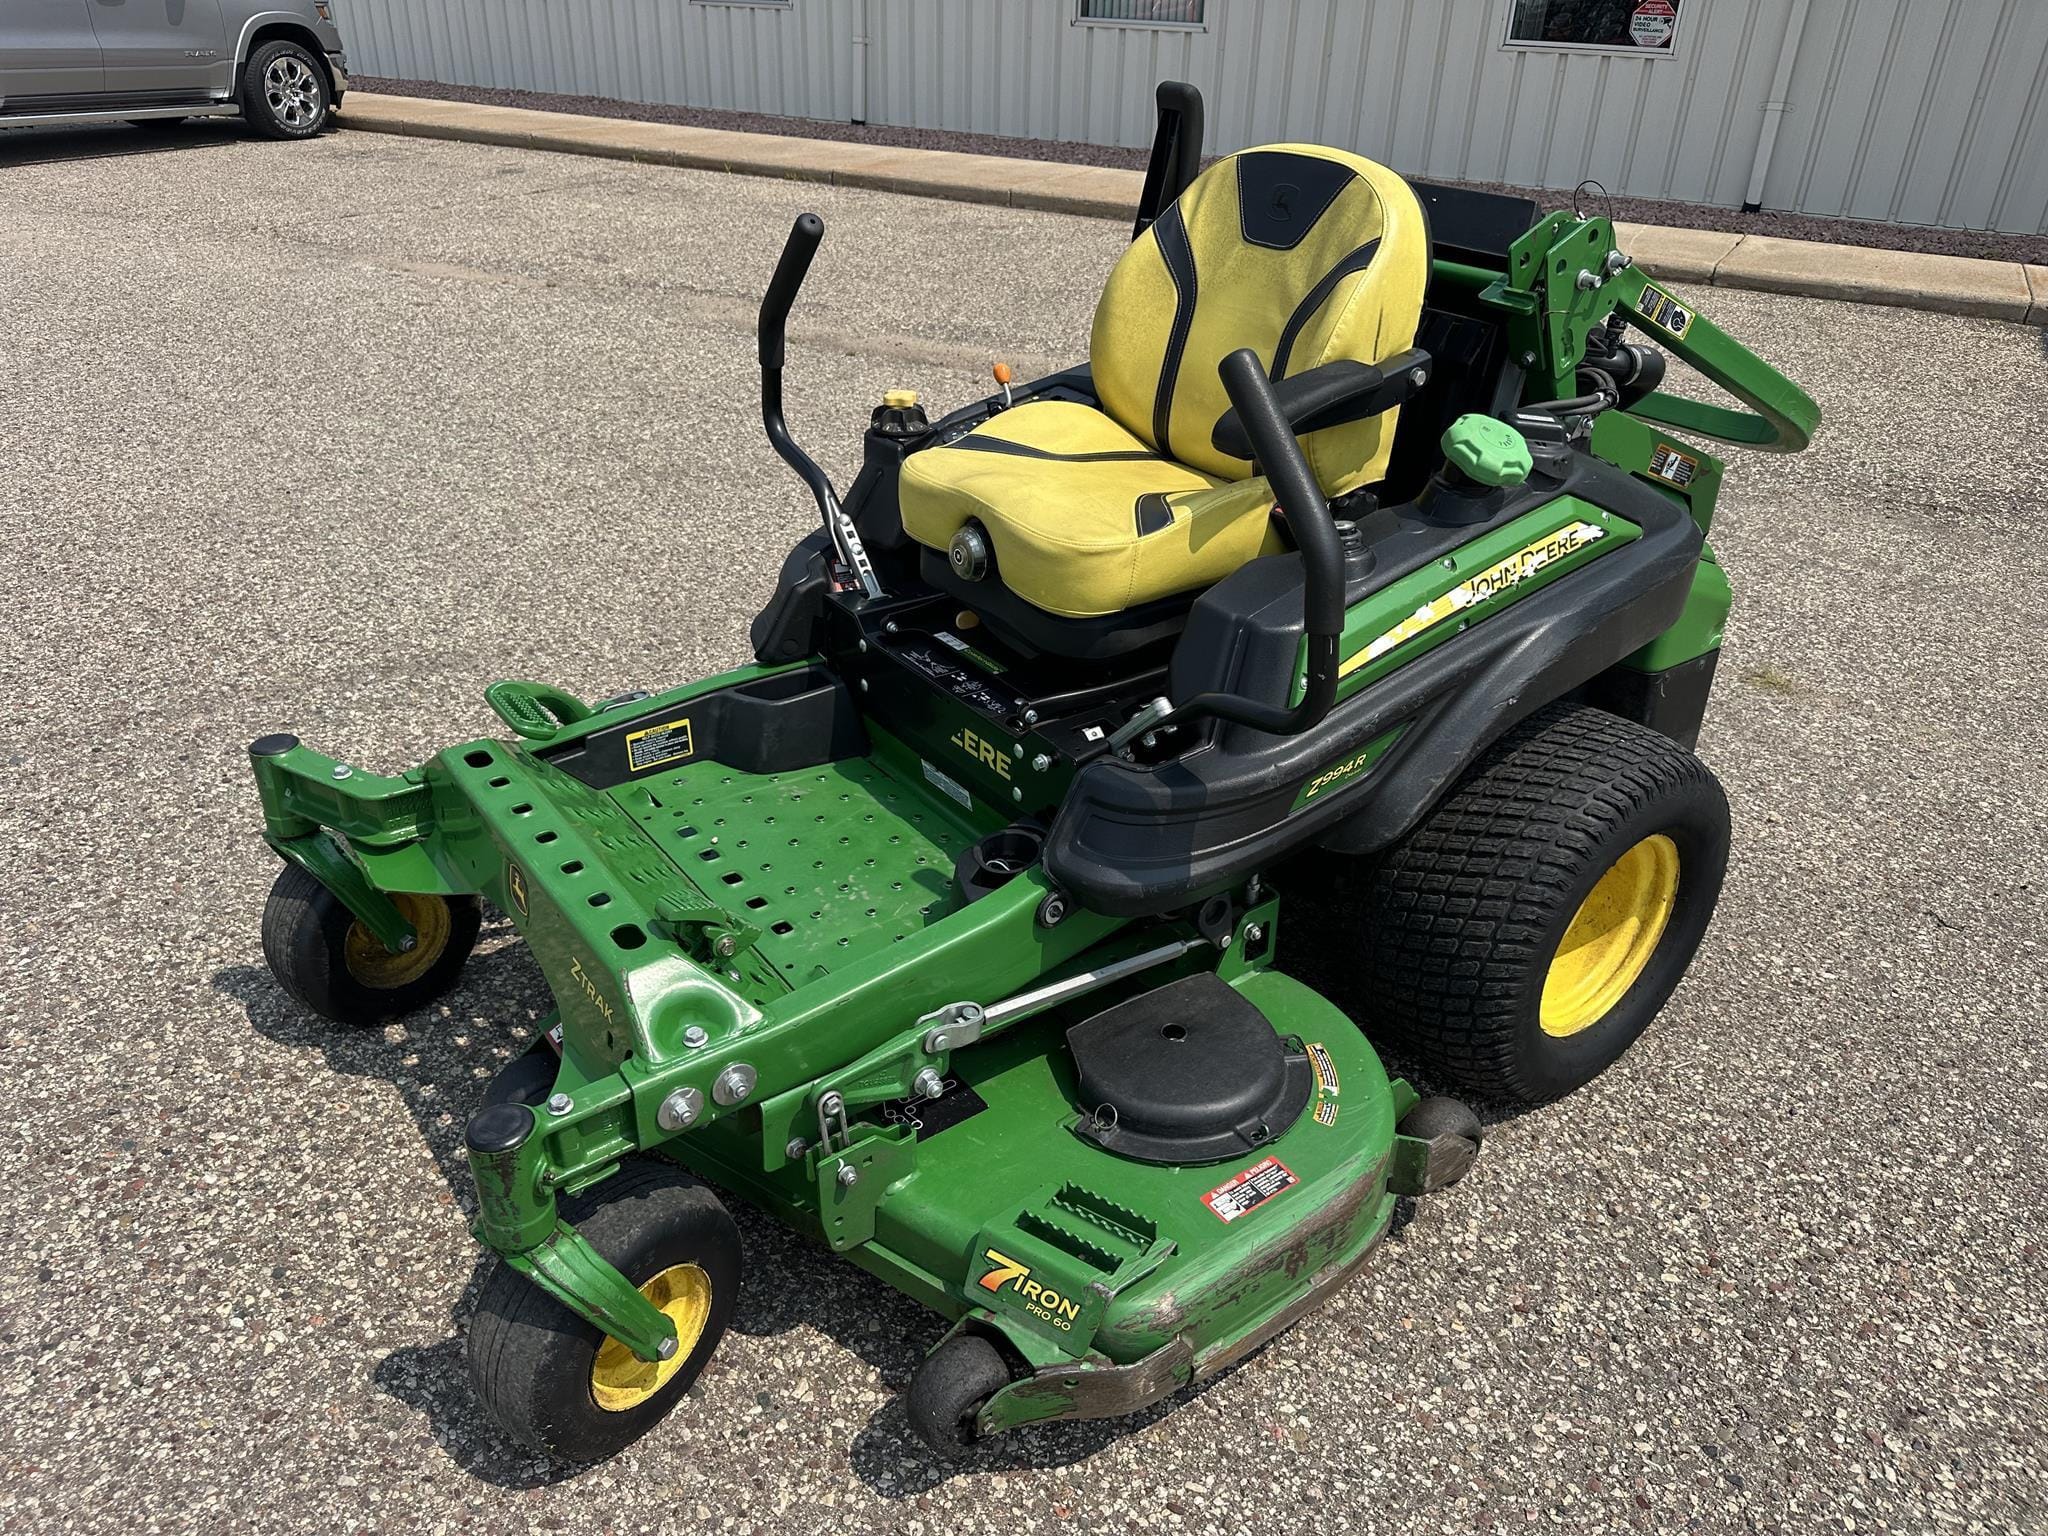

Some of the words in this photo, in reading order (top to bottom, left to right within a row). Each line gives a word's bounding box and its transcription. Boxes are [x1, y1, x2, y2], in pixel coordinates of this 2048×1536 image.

[1306, 753, 1367, 798] Z994R
[570, 956, 615, 1025] ZTRAK
[1216, 1178, 1240, 1196] DANGER
[1025, 1301, 1051, 1321] PRO
[1052, 1317, 1071, 1331] 60
